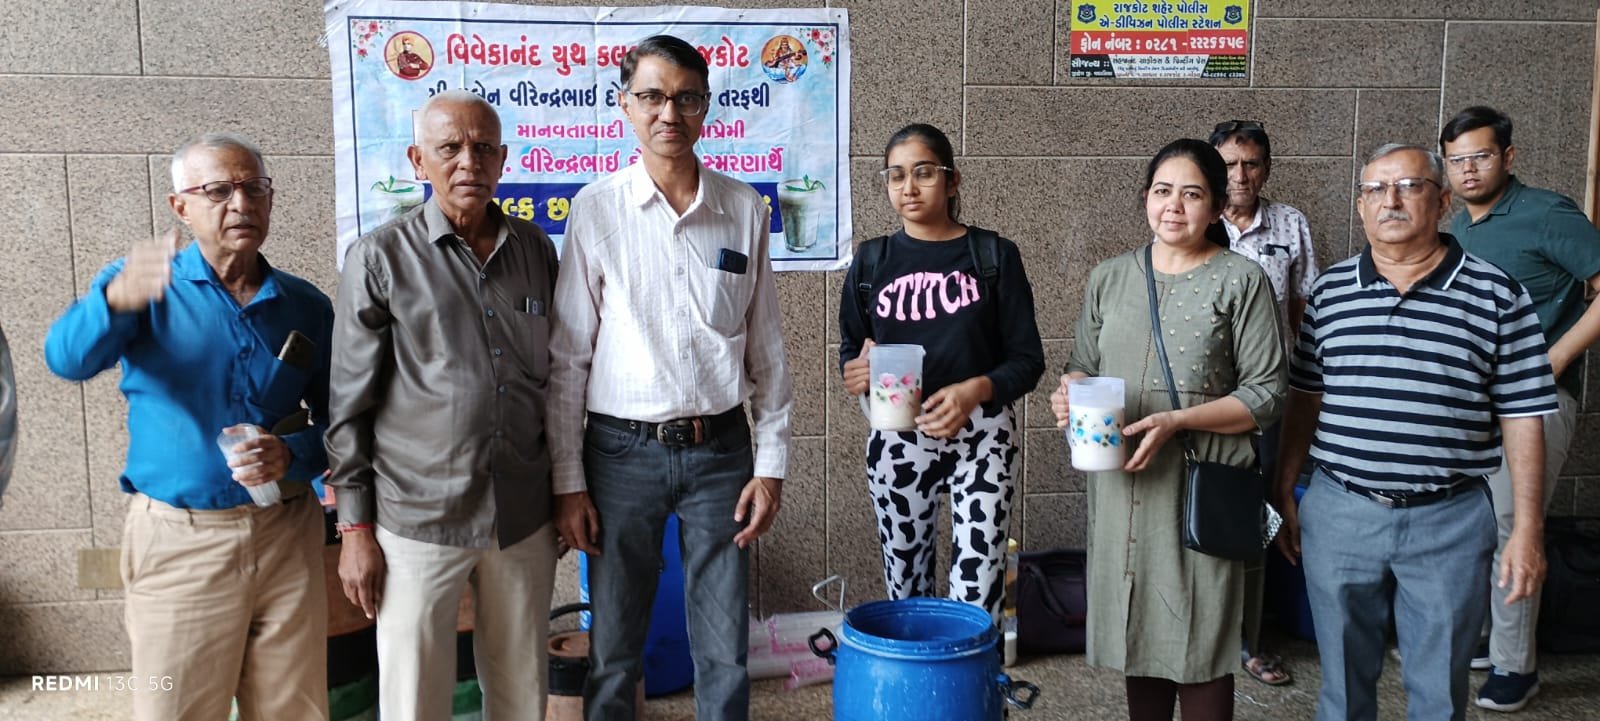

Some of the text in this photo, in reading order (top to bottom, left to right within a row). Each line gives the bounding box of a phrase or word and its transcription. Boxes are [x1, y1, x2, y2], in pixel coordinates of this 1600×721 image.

[1114, 0, 1208, 14] રાજકોટ શહેર પોલીસ
[1157, 16, 1188, 28] પોલીસ
[1192, 16, 1221, 28] સ્ટેશન
[447, 33, 542, 66] વિવેકાનંદ
[552, 43, 586, 76] યુથ
[1081, 32, 1101, 53] ફોન
[1105, 32, 1132, 50] નંબર
[1146, 38, 1177, 51] ૦૨૮૧
[509, 81, 598, 108] વીરેન્દ્રભાઈ
[718, 82, 770, 107] તરફથી
[517, 119, 624, 138] માનવતાવાદી
[521, 147, 620, 174] વીરેન્દ્રભાઈ
[876, 270, 980, 321] STITCH
